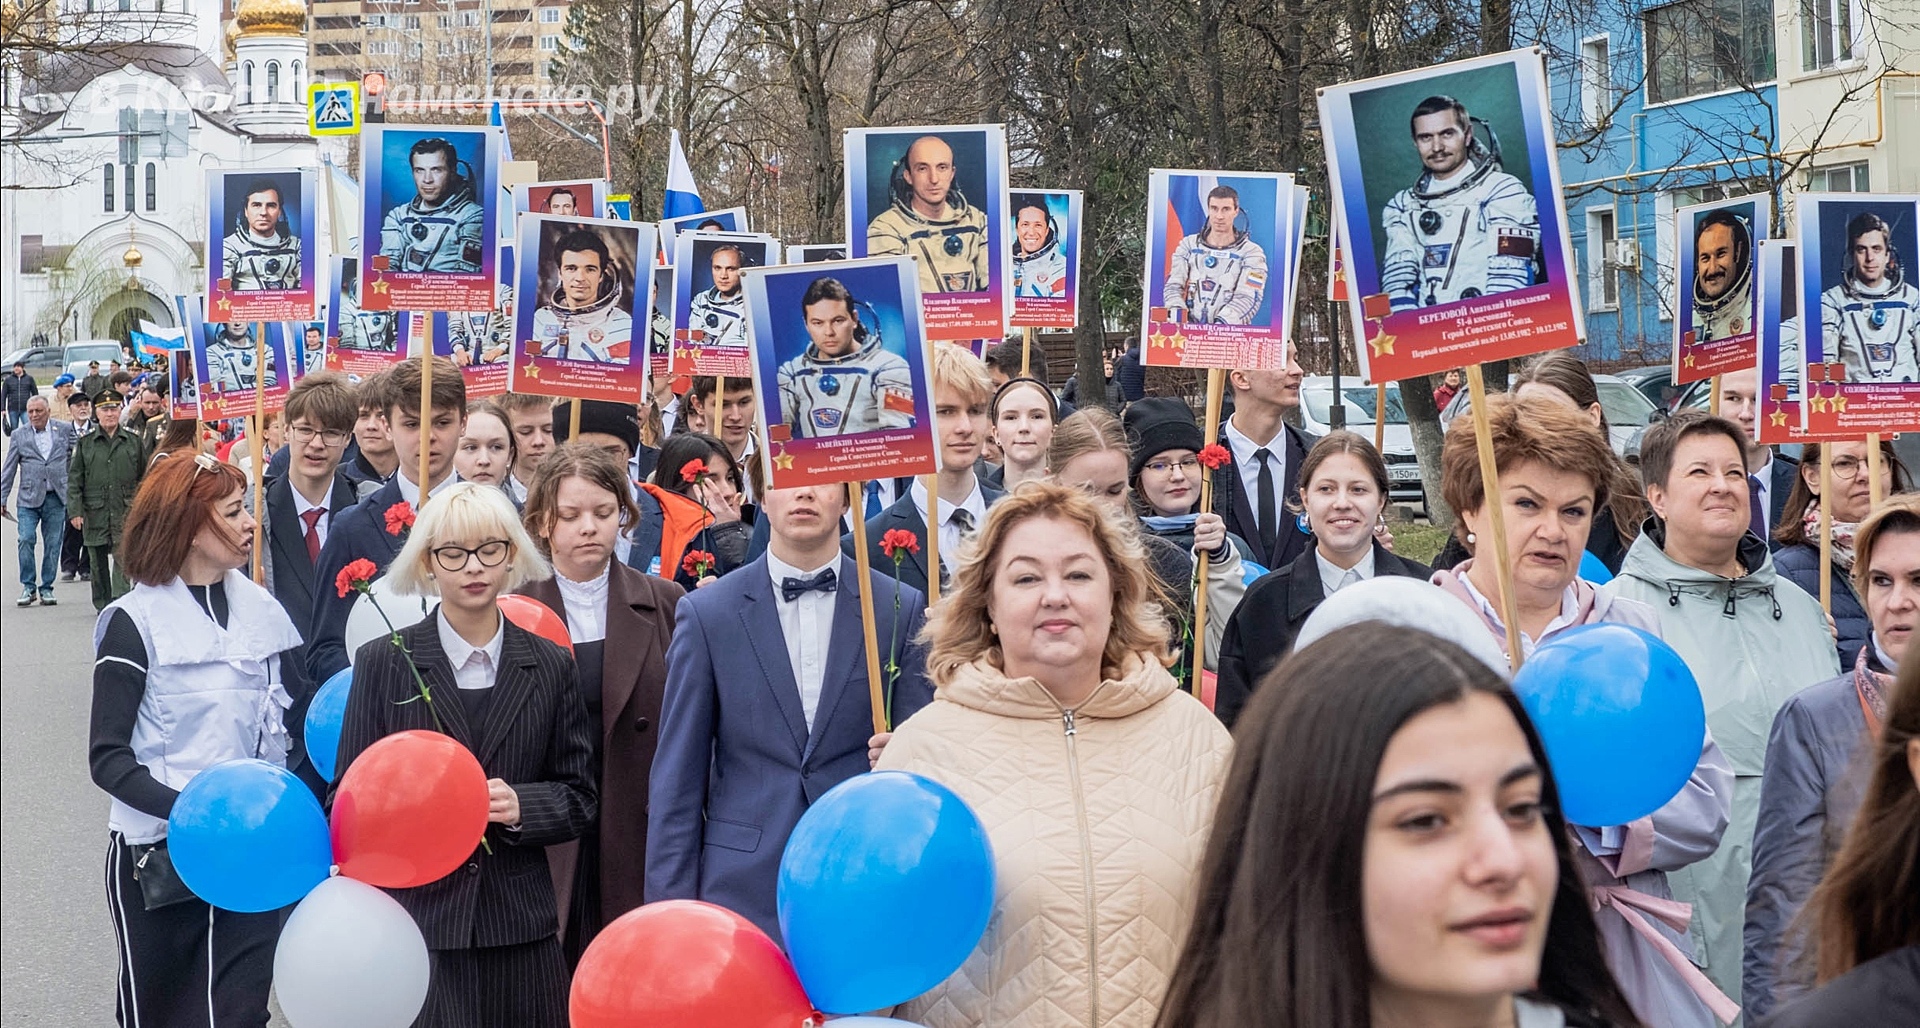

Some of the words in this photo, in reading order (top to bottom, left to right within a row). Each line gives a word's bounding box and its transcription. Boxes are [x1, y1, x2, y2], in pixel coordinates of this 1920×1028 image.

[1419, 306, 1468, 325] БЕРЕЗОВОЙ
[1470, 300, 1505, 315] Анатолий
[1506, 293, 1551, 308] Николаевич
[1442, 329, 1464, 341] Герой
[1466, 322, 1507, 336] Советского
[1508, 316, 1533, 328] Союза.
[1456, 316, 1473, 328] 51-й
[1412, 347, 1438, 359] Первый
[1439, 339, 1480, 354] космический
[1481, 335, 1499, 346] полёт
[1500, 328, 1531, 341] 13.05.1982
[1536, 322, 1568, 335] 10.12.1982
[815, 440, 853, 449] ЛАВЕЙКИН
[854, 437, 885, 445] Александр
[830, 455, 847, 463] Герой
